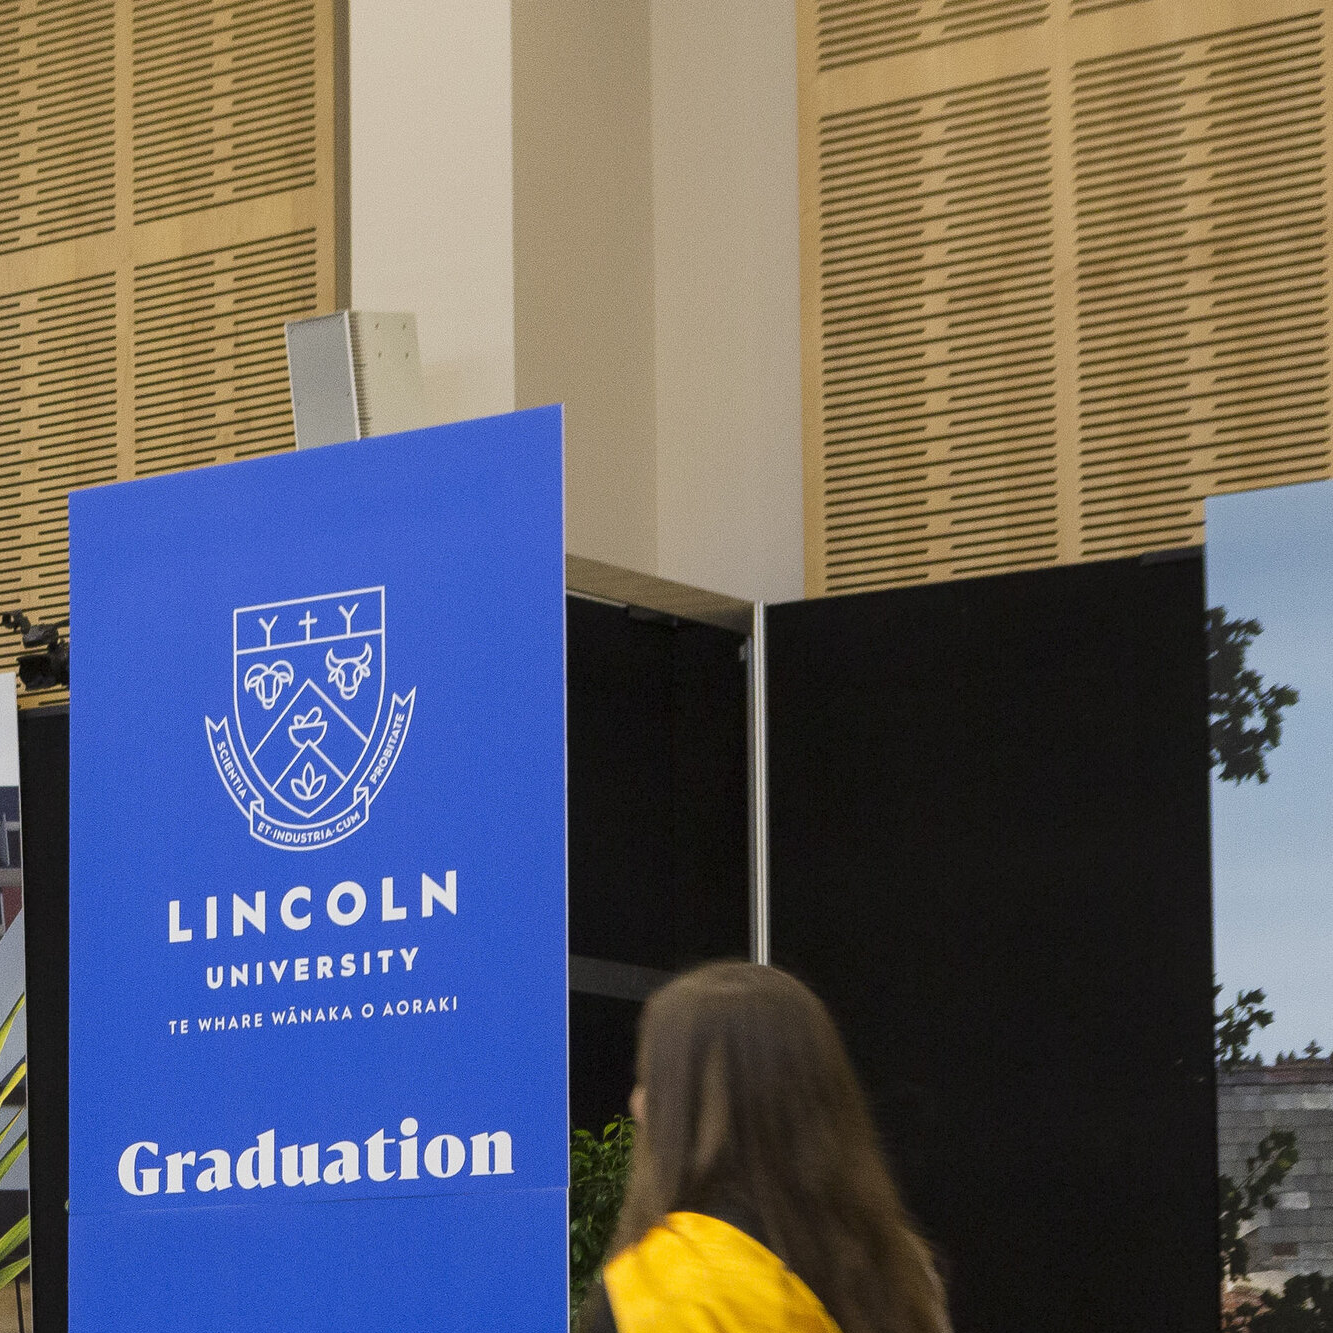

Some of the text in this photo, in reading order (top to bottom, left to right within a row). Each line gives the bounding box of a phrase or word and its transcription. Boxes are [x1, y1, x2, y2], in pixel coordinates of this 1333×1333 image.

[216, 740, 248, 800] SCIENTIA
[369, 713, 405, 784] PROBITATE
[169, 870, 458, 943] LINCOLN
[207, 947, 420, 990] UNIVERSITY
[168, 1019, 189, 1035] TE
[198, 1012, 263, 1033] WHARE
[361, 1003, 375, 1019] O
[381, 995, 457, 1017] AORAKI
[118, 1118, 516, 1197] Graduation
